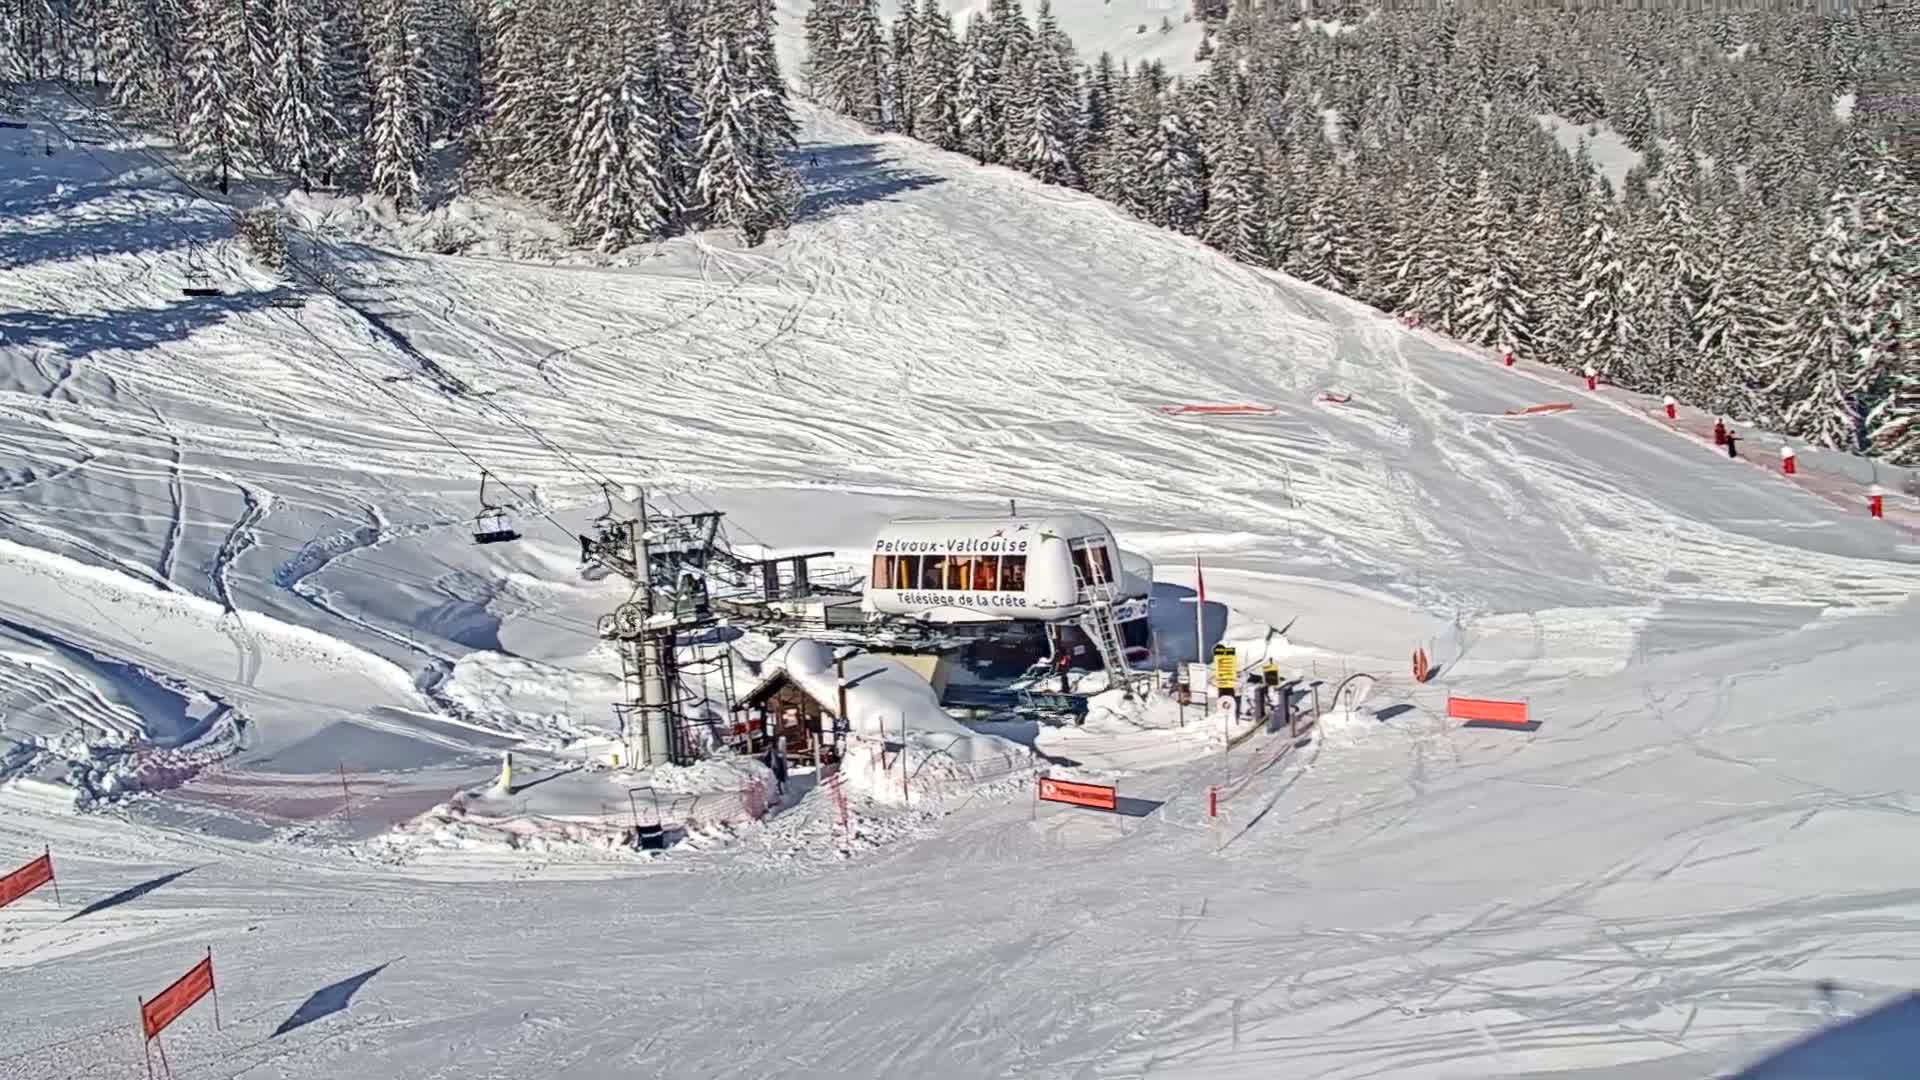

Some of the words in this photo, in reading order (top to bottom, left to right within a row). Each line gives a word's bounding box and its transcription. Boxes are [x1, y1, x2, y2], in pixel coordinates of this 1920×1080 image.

[875, 538, 1028, 553] Pelvoux-Vallouise
[897, 592, 954, 606] Télésiège
[959, 594, 973, 606] de
[977, 594, 989, 607] la
[991, 594, 1027, 608] Crête
